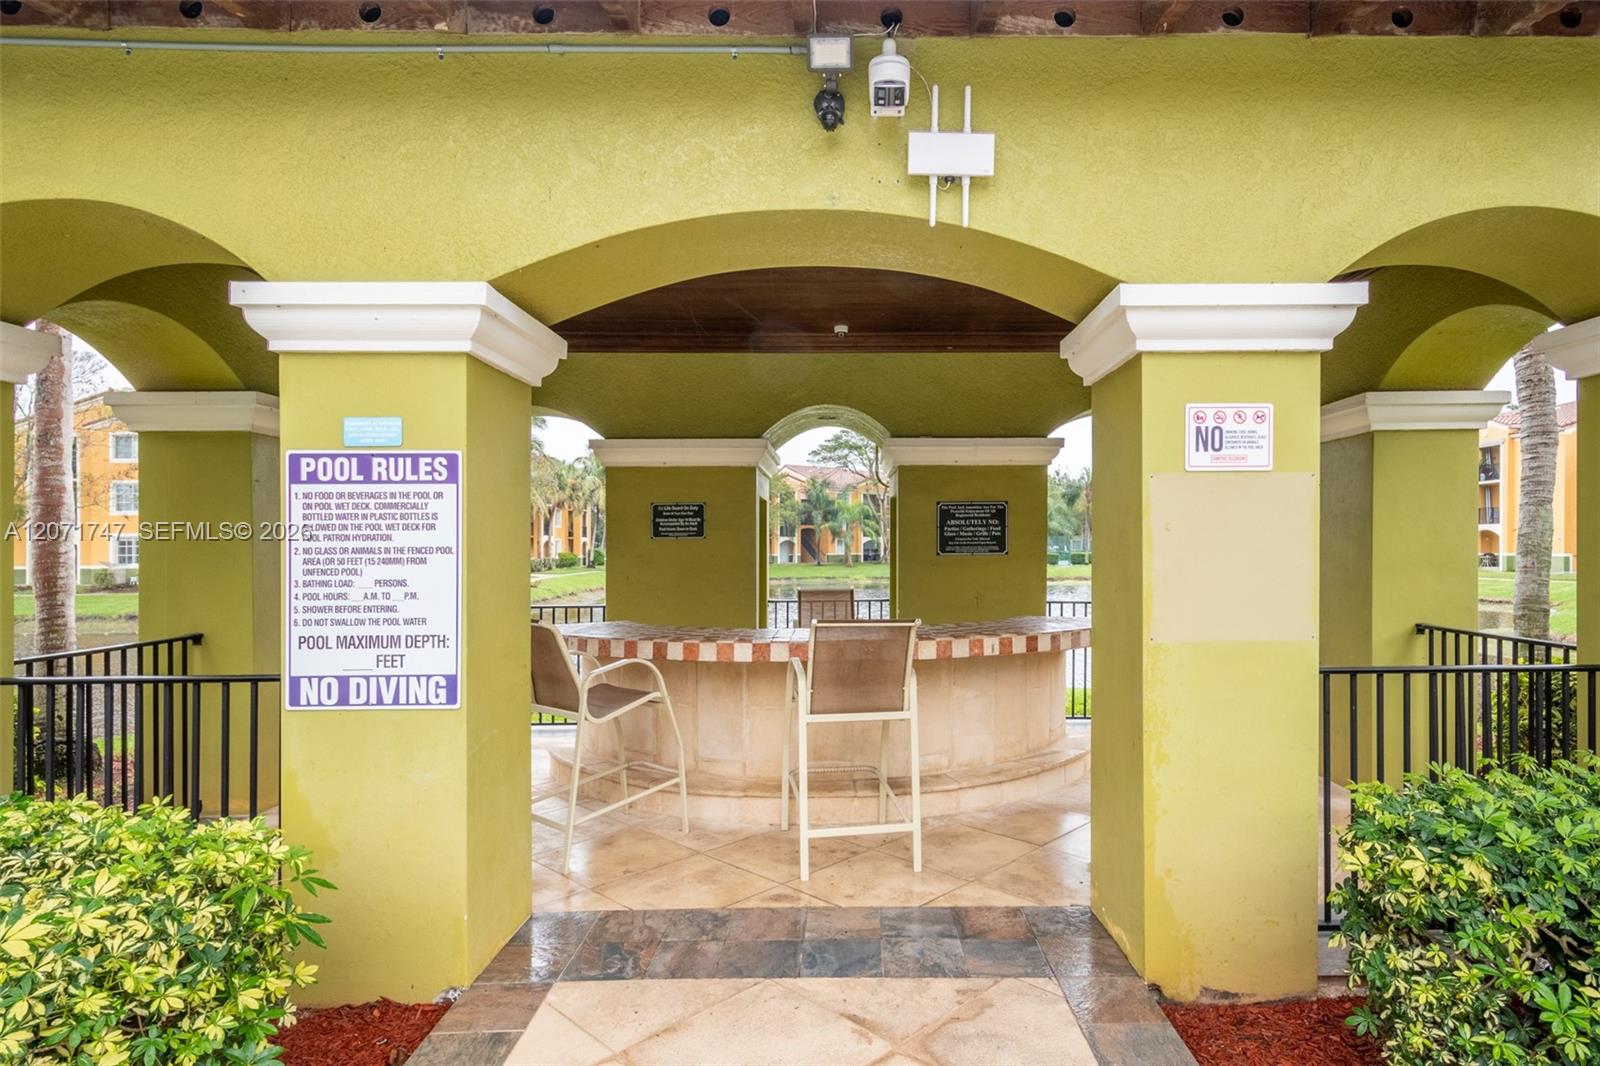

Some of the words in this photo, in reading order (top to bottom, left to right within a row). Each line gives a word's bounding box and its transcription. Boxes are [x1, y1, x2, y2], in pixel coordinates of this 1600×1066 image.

[1196, 426, 1223, 452] NO
[300, 457, 363, 481] POOL
[372, 457, 448, 481] RULES
[323, 533, 351, 542] PATRON
[352, 533, 393, 542] HYDRATION.
[303, 557, 321, 566] AREA
[322, 557, 335, 566] (OR
[337, 557, 345, 566] 50
[347, 557, 362, 566] FEET
[364, 557, 375, 566] (15
[406, 557, 427, 566] FROM
[303, 568, 339, 577] UNFENCED
[341, 568, 362, 577] POOL)
[294, 618, 300, 627] 6.
[303, 618, 312, 627] DO
[314, 618, 328, 627] NOT
[330, 618, 366, 627] SWALLOW
[368, 618, 381, 627] THE
[383, 618, 401, 627] POOL
[403, 618, 427, 627] WATER
[298, 635, 332, 649] POOL
[336, 635, 401, 649] MAXIMUM
[405, 635, 449, 649] DEPTH:
[376, 655, 405, 668] FEET
[300, 676, 338, 705] NO
[350, 676, 447, 705] DIVING
